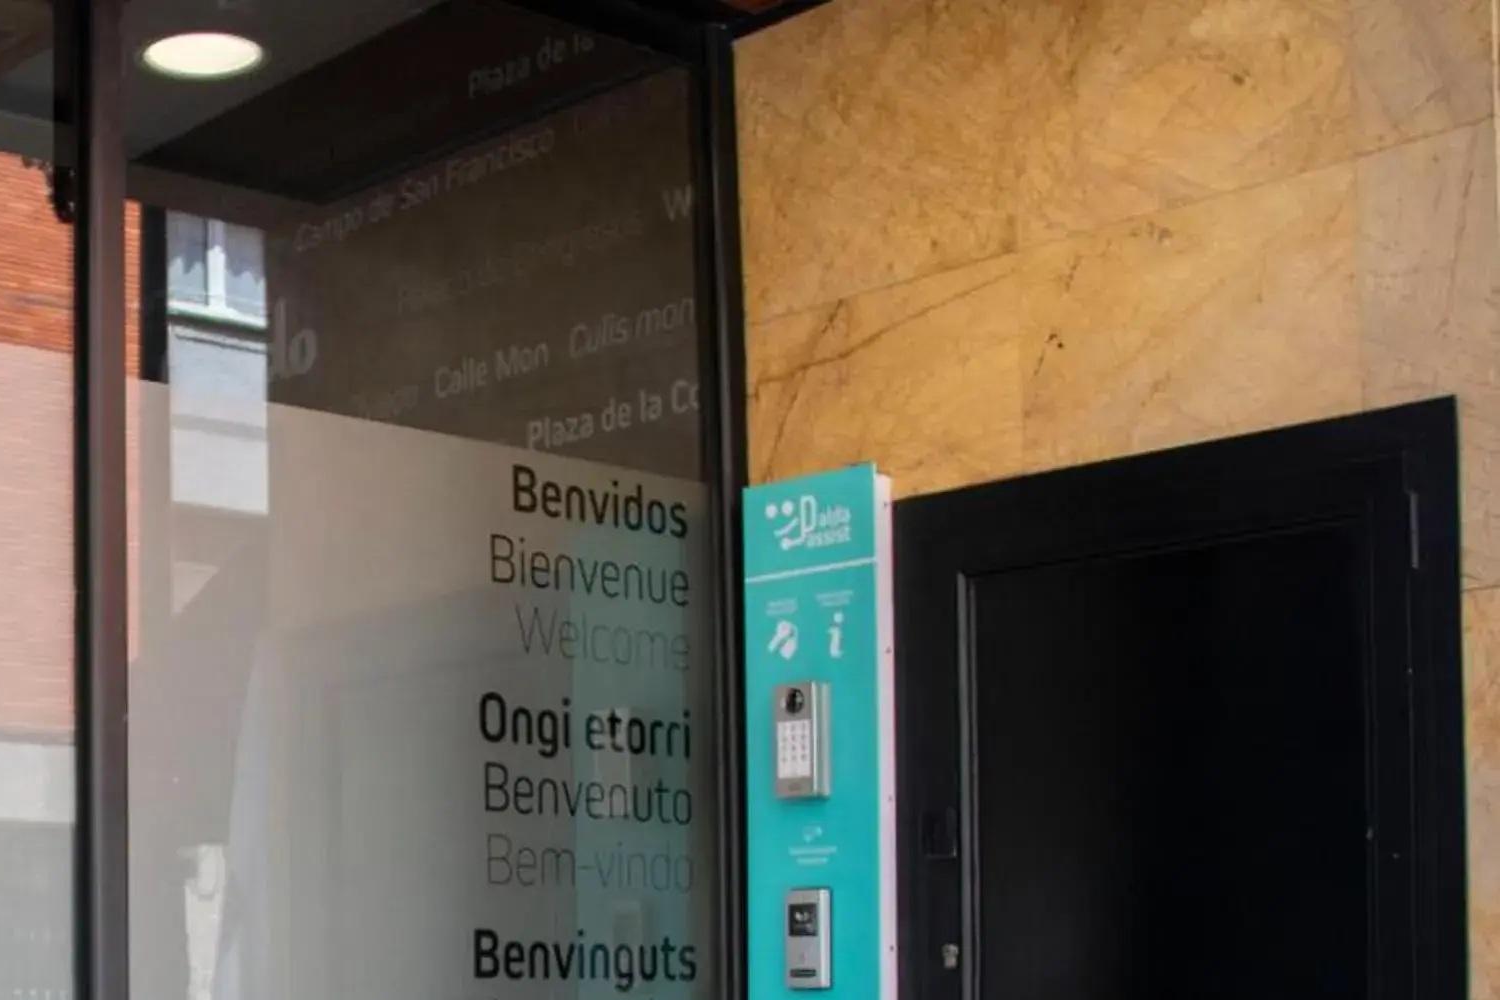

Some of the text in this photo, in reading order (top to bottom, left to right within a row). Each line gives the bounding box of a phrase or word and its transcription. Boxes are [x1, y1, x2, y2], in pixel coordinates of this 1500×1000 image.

[445, 127, 556, 192] Francisco
[434, 355, 488, 400] Calle
[494, 341, 549, 382] Mon
[525, 412, 595, 451] Plaza
[600, 395, 633, 433] de
[638, 387, 663, 424] la
[512, 463, 688, 538] Benvidos
[490, 533, 690, 607] Bienvenue
[514, 600, 692, 671] Welcome
[479, 691, 691, 760] Ongi etorri
[484, 761, 693, 826] Benvenuto
[486, 832, 695, 894] Bem-vindo
[473, 927, 698, 993] Benvinguts
